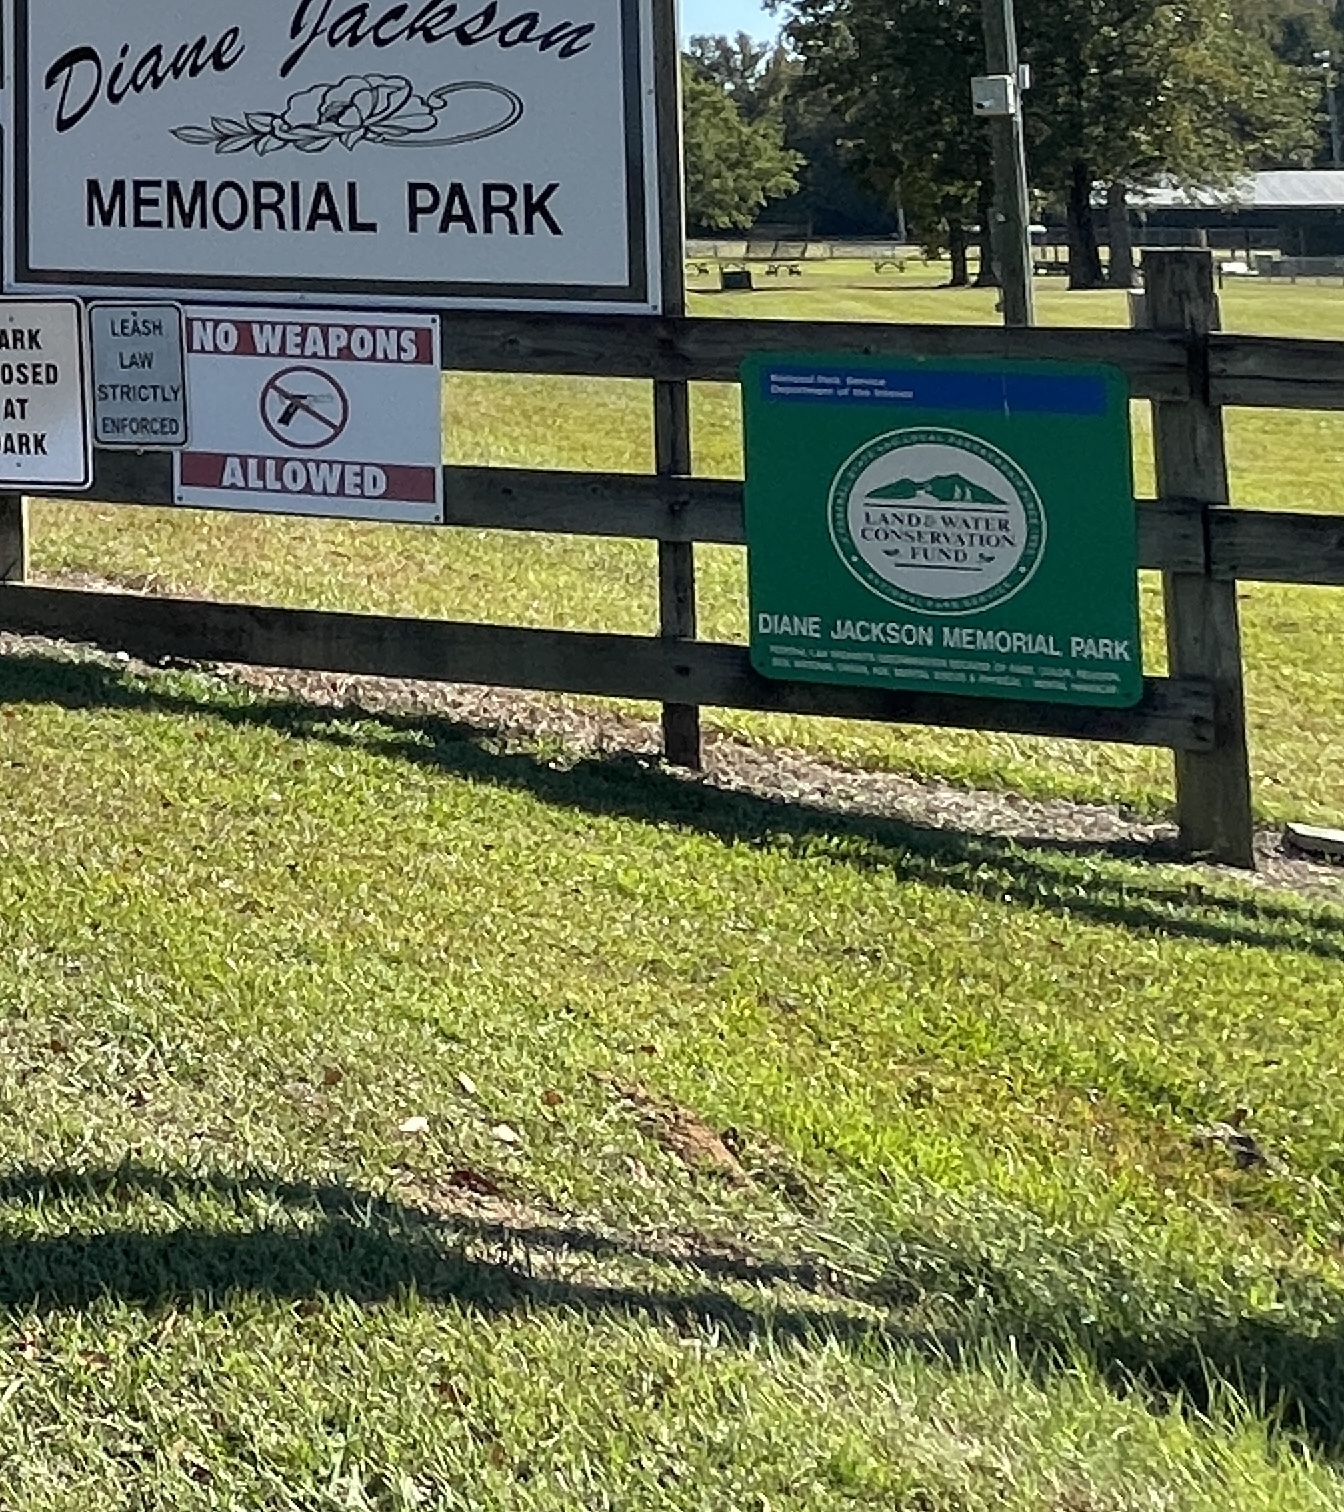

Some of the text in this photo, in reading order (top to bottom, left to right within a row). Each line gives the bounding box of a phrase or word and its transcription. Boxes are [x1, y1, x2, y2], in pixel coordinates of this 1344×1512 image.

[45, 25, 246, 133] Diane
[85, 178, 564, 237] MEMORIAL PARK
[111, 318, 163, 337] LEASH
[191, 320, 418, 361] NO WEAPONS
[119, 351, 154, 369] LAW
[97, 384, 181, 402] STRICTLY
[3, 398, 29, 421] AT
[102, 417, 180, 435] ENFORCED
[220, 457, 388, 497] ALLOWED
[864, 511, 921, 527] LAND
[940, 514, 1011, 532] WATER
[860, 527, 1017, 548] CONSERVATION
[910, 546, 968, 563] FUND
[758, 613, 821, 638] DIANE
[830, 620, 933, 647] JACKSON
[942, 627, 1063, 657] MEMORIAL
[1070, 637, 1131, 662] PARK
